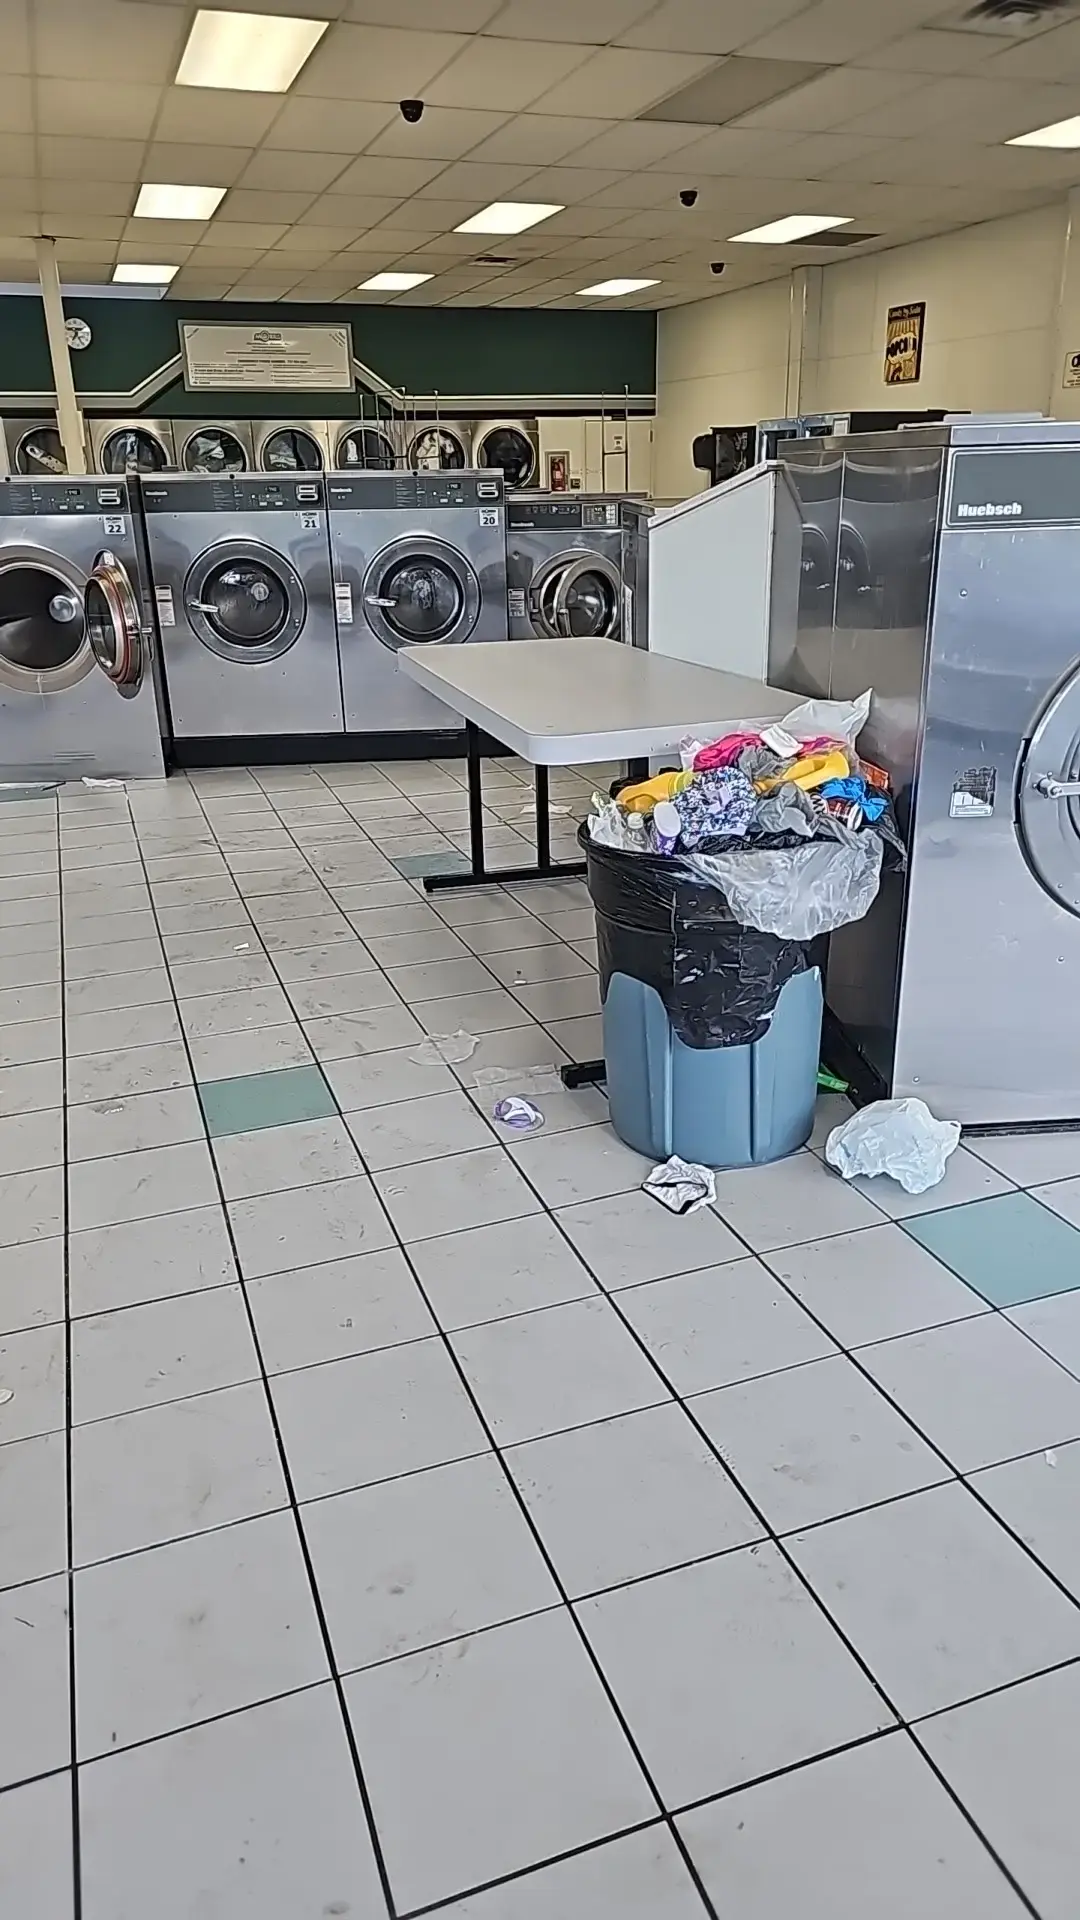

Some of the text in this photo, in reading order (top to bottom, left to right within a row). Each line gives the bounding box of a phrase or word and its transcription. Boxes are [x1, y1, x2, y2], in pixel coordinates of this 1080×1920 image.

[886, 336, 917, 359] POPCON
[957, 502, 1022, 517] Huebsch
[304, 519, 317, 528] 21
[483, 516, 496, 525] 20
[108, 524, 122, 533] 22
